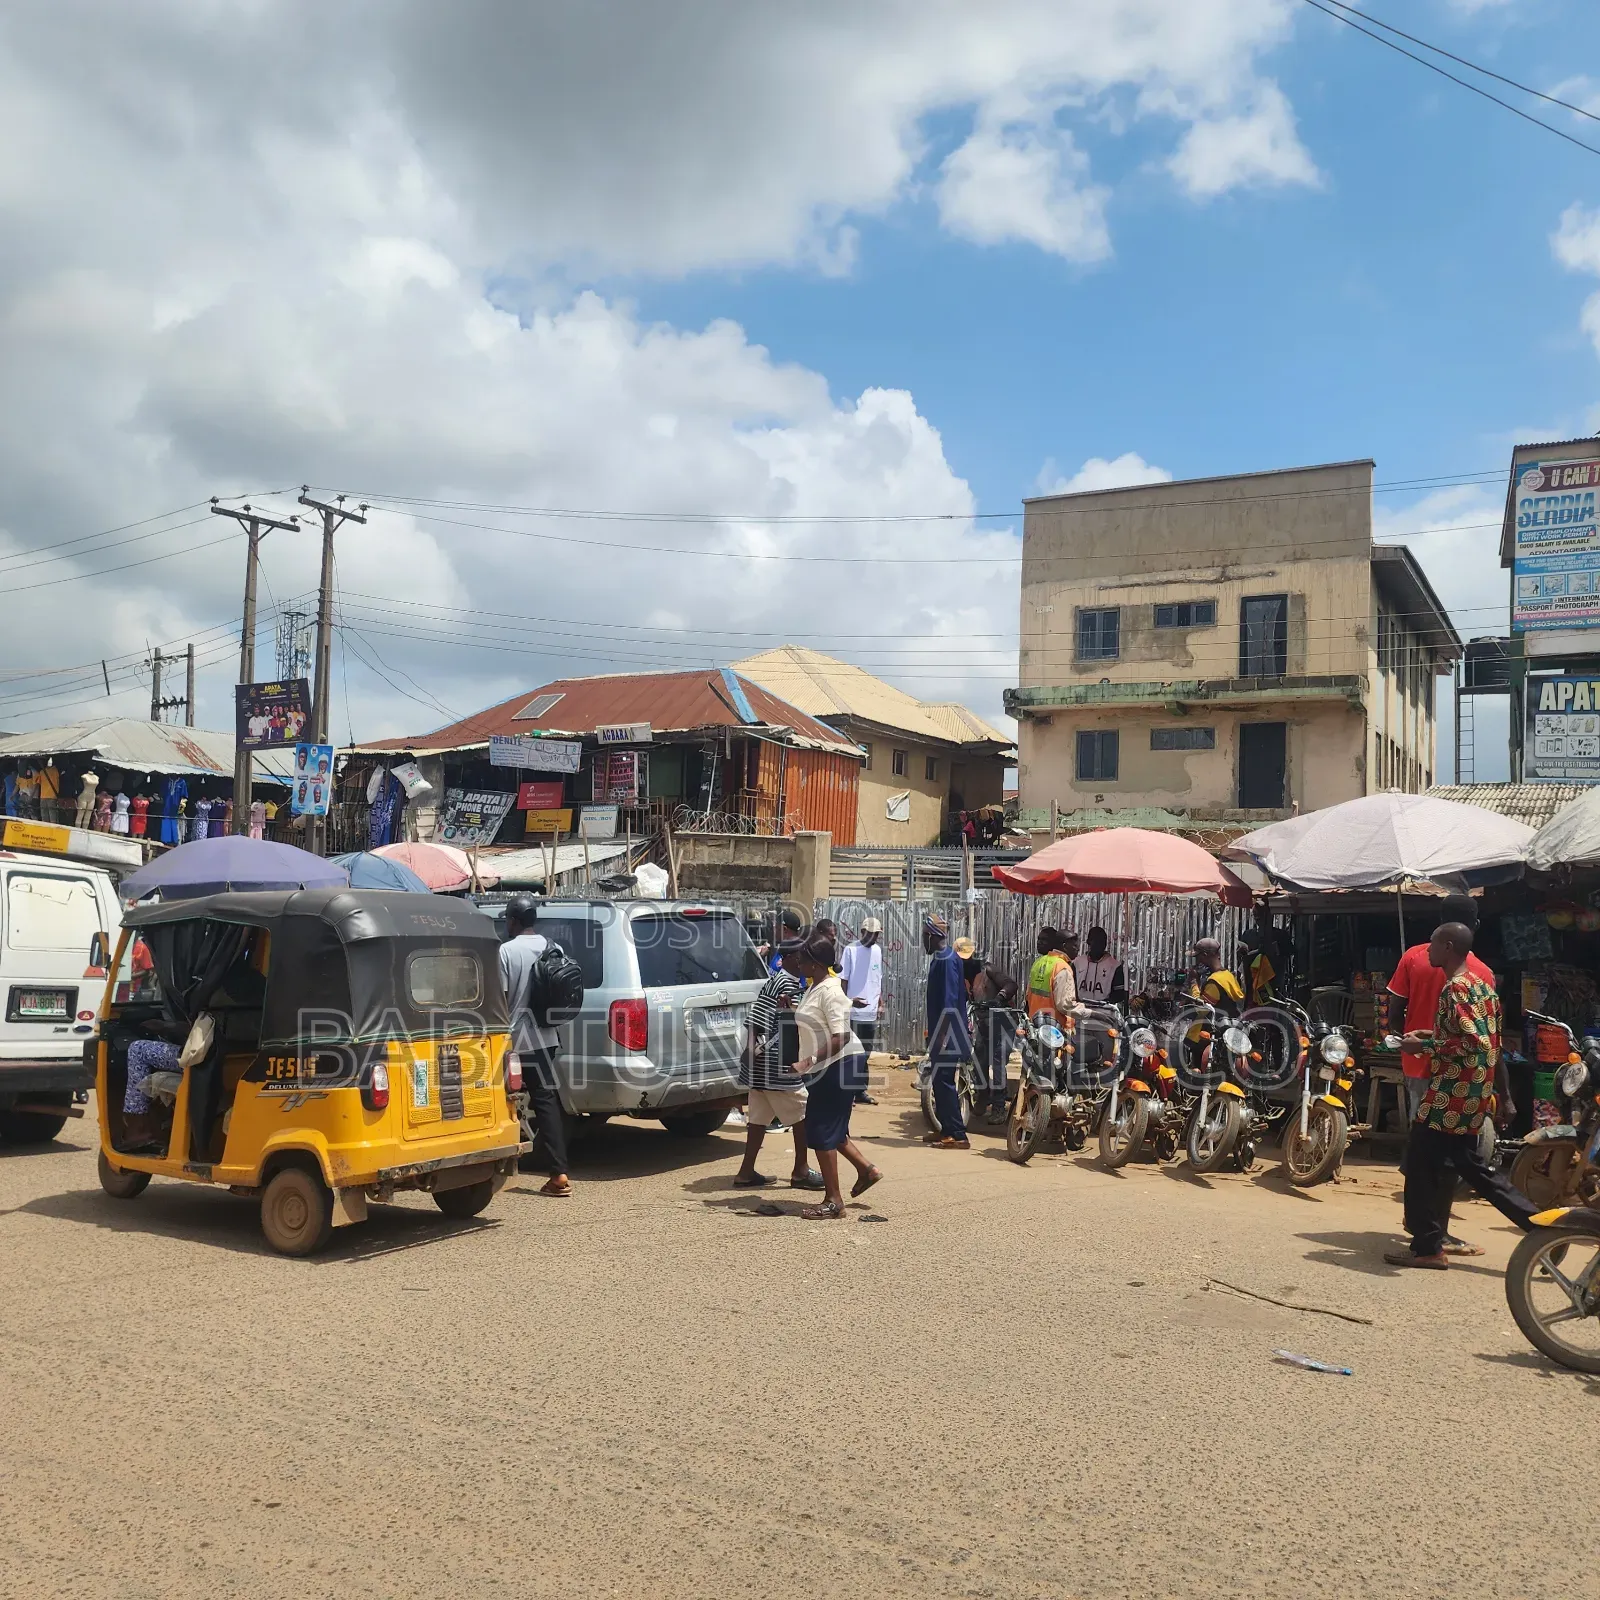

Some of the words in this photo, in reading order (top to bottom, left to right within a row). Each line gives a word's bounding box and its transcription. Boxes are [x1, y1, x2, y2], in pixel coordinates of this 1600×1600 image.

[1551, 469, 1560, 487] U
[1563, 466, 1590, 486] CAN
[1521, 530, 1546, 538] DIRECT
[1547, 526, 1592, 535] EMPLOYMENT
[1540, 533, 1561, 541] WORK
[1562, 531, 1588, 539] PERMIT
[1520, 604, 1553, 612] PASSPORT
[1554, 601, 1599, 610] PHOTOGRAPH
[463, 792, 501, 804] APATA
[456, 801, 482, 813] PHONE
[410, 914, 457, 930] JESUS
[1078, 979, 1103, 994] AIA
[437, 1043, 459, 1055] TVS
[266, 1056, 316, 1079] JESUS
